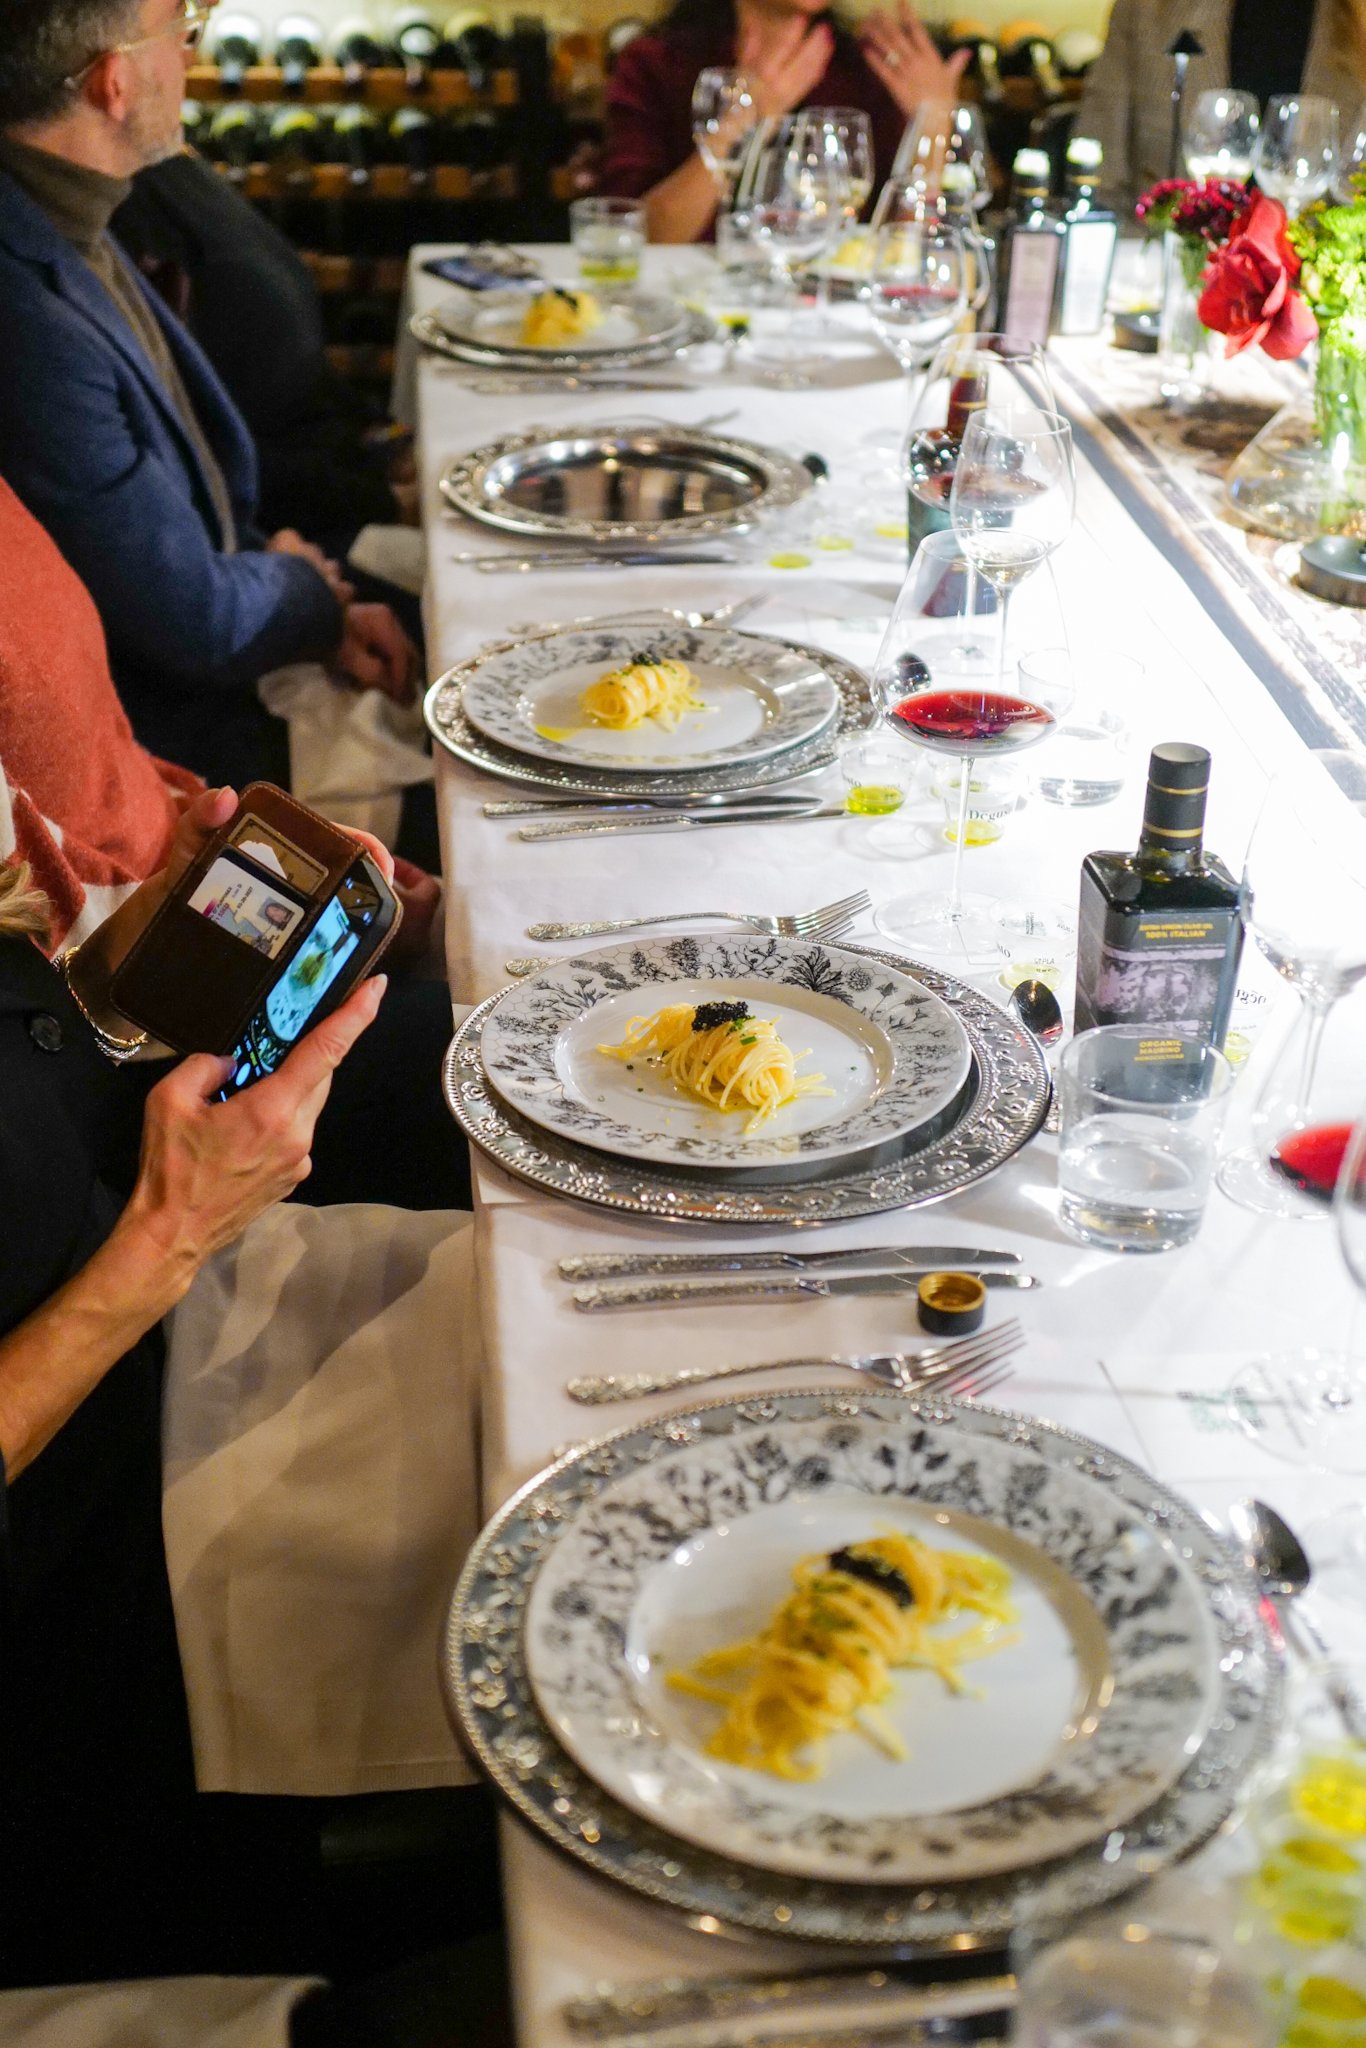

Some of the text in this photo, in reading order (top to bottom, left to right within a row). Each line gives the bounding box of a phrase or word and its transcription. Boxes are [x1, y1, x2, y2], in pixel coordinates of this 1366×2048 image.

[1145, 930, 1206, 939] 100% ITALIAN
[1139, 1040, 1182, 1048] ORGANIC
